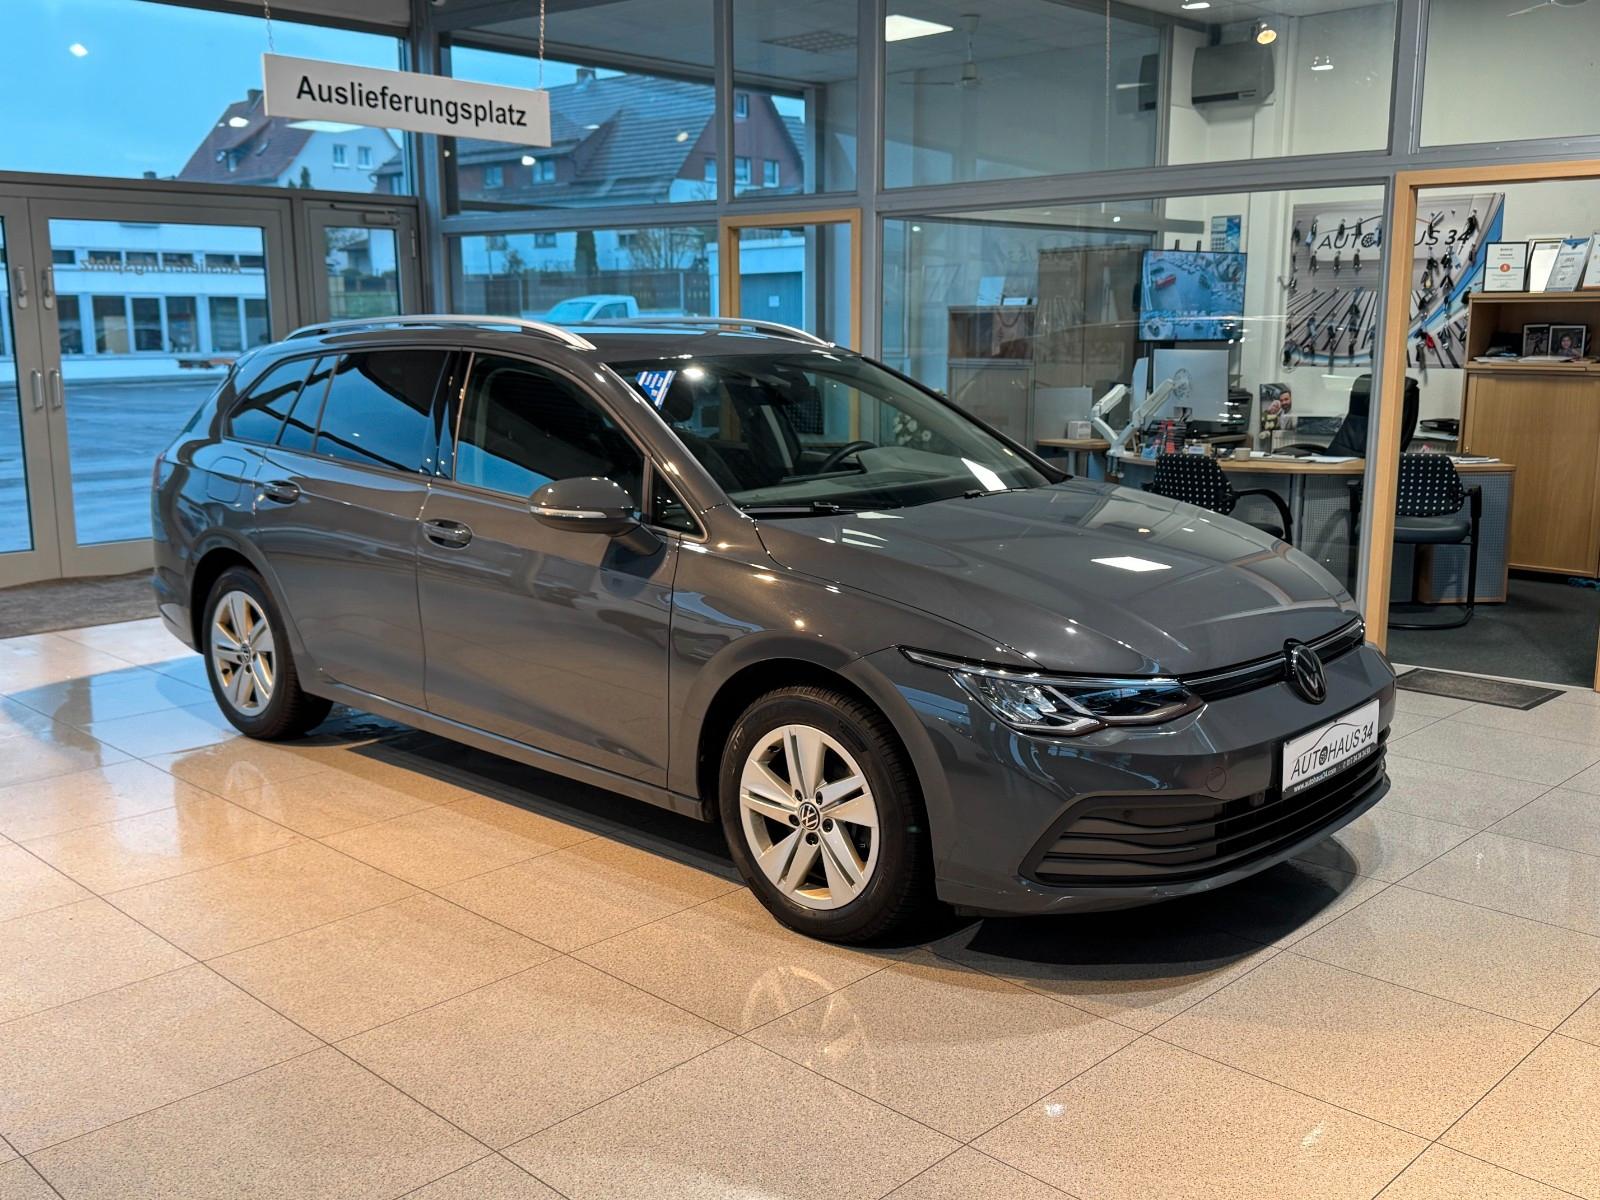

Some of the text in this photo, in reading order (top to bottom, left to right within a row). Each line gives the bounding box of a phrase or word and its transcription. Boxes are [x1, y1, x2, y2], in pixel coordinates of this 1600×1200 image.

[296, 75, 527, 127] Auslieferungsplatz
[1445, 229, 1471, 246] 34
[1290, 728, 1361, 780] AUTOHAUS
[1361, 721, 1374, 744] 34
[1293, 767, 1337, 793] www.autohaus34.com
